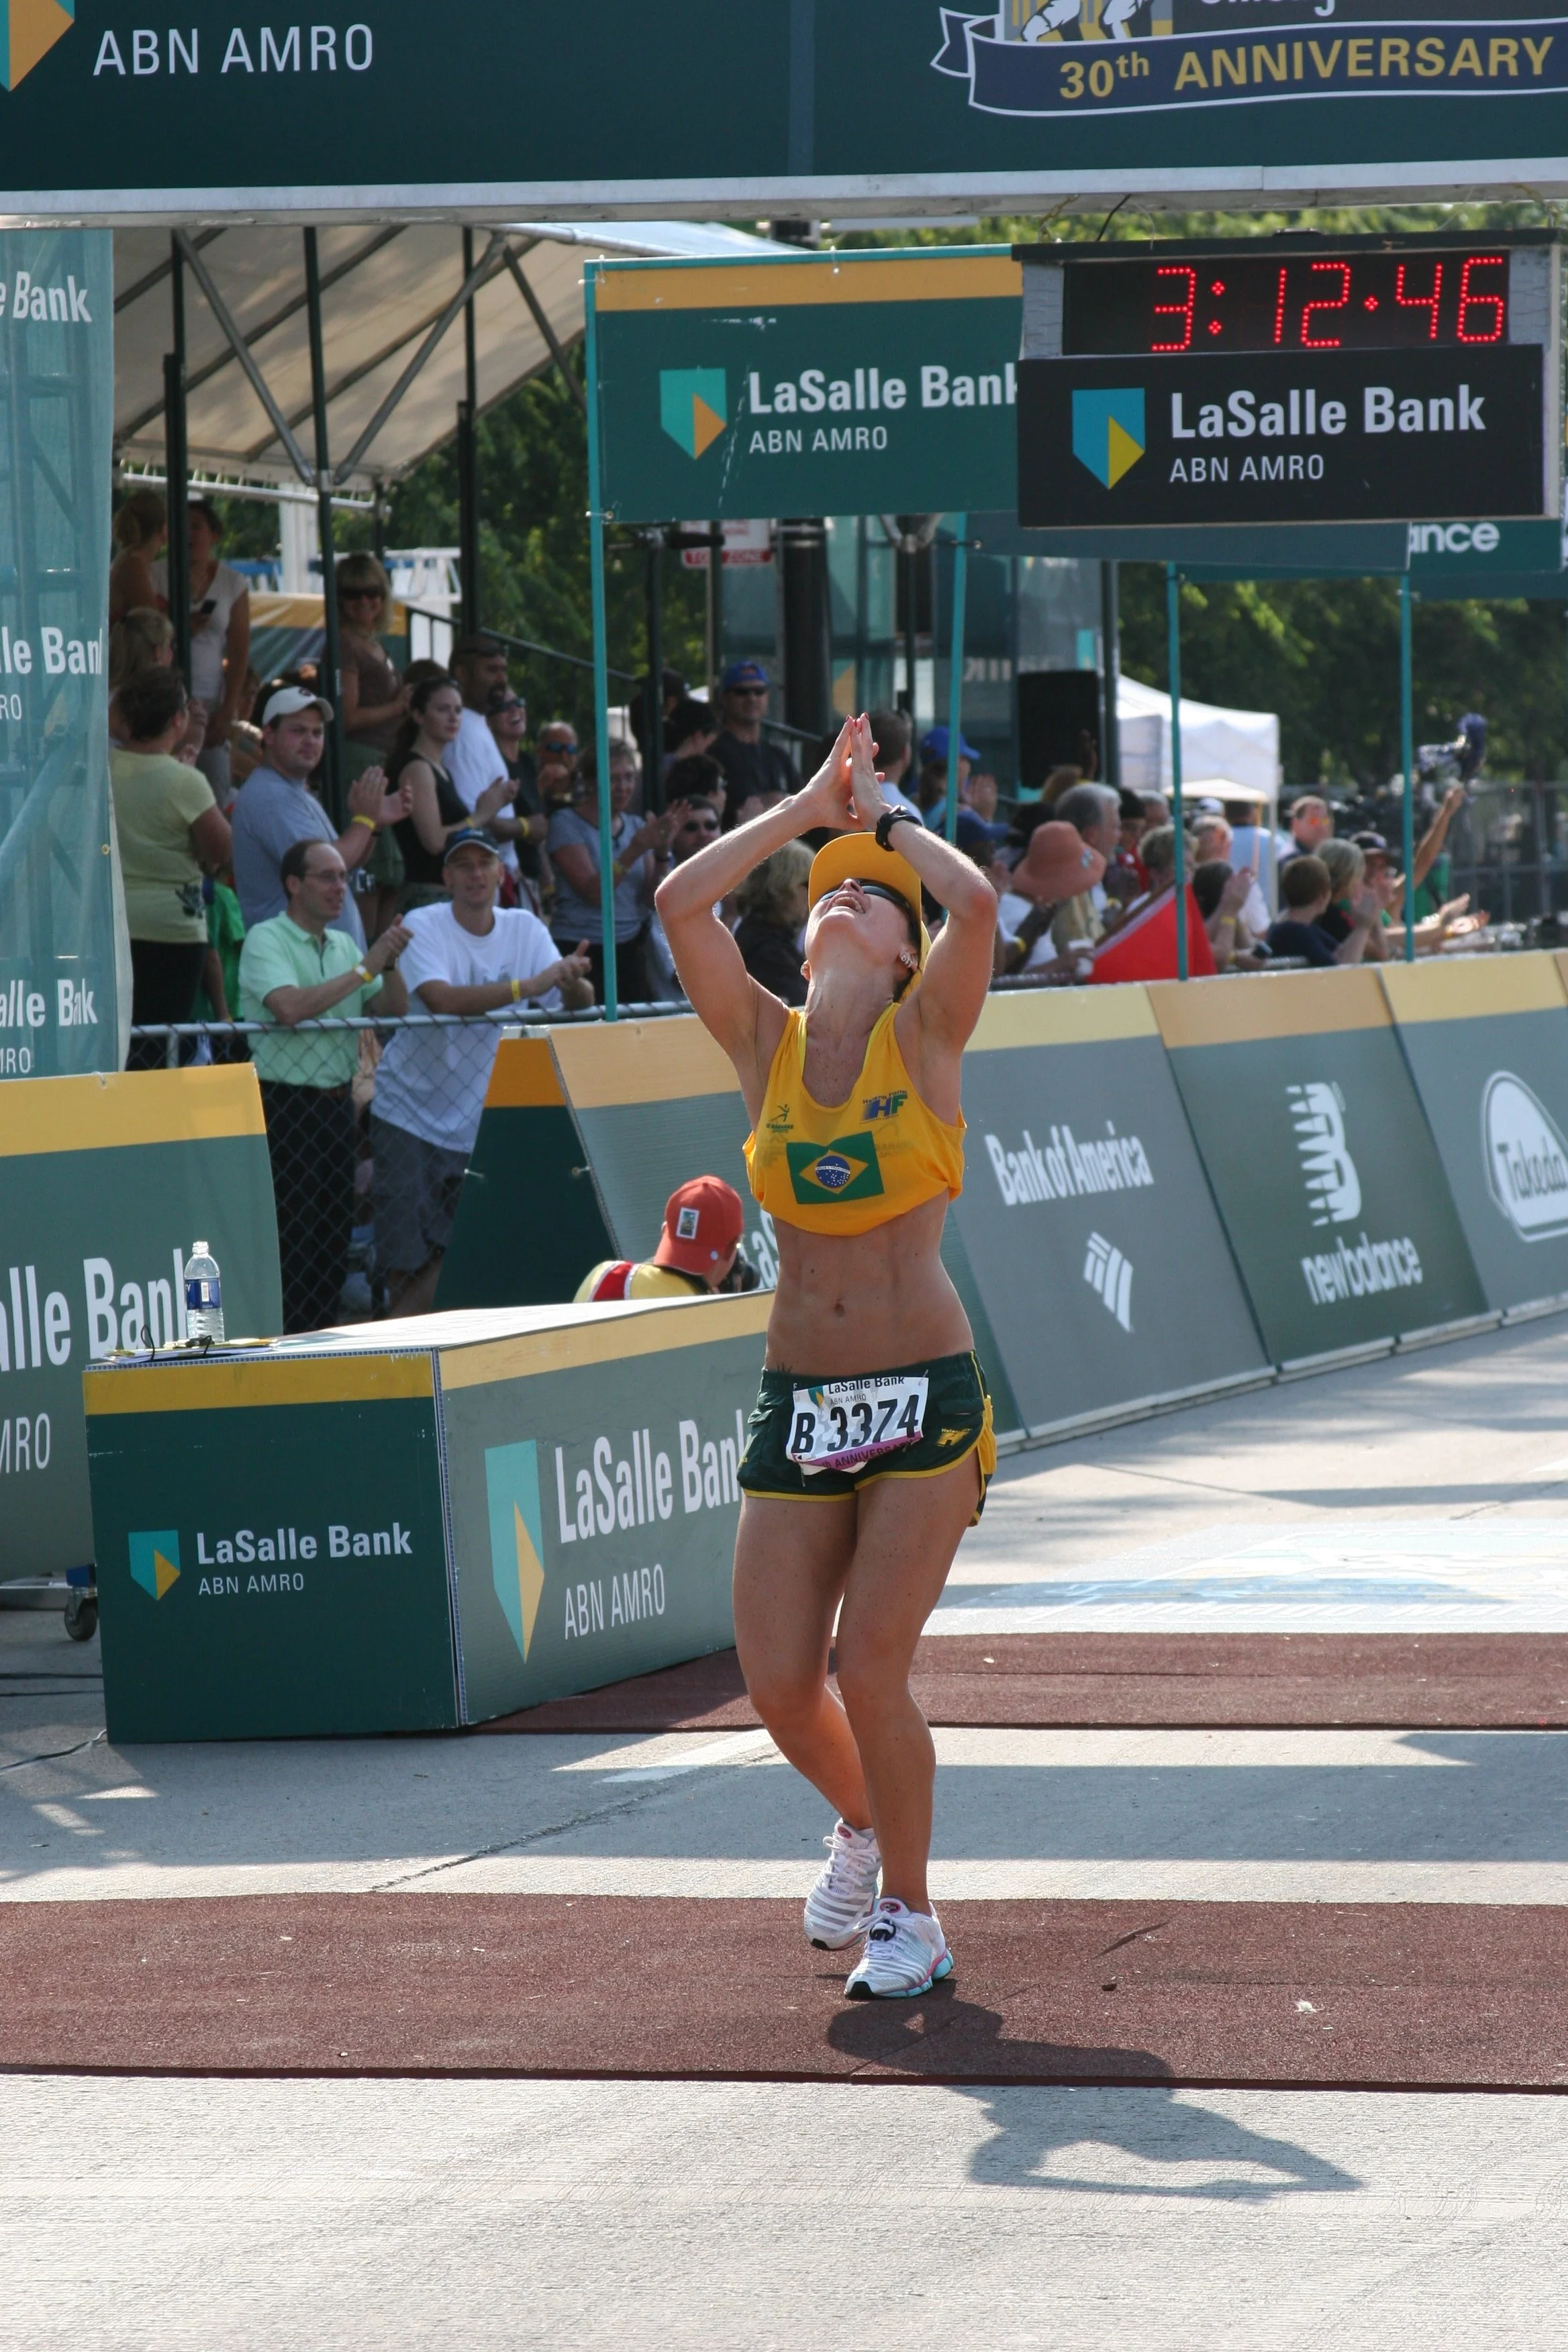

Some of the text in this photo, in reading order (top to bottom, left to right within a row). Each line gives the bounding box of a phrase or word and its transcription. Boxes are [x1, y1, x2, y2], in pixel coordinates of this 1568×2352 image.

[93, 23, 373, 76] ABN AMRO
[1059, 36, 1554, 99] 30th ANNIVERSARY
[13, 271, 92, 322] Bank
[748, 368, 907, 413] LaSalle
[1171, 384, 1486, 438] LaSalle Bank
[748, 426, 888, 454] ABN AMRO
[1169, 453, 1325, 483] ABN AMRO
[41, 626, 102, 674] Ban
[985, 1120, 1155, 1206] Bank of America
[828, 1376, 905, 1395] LaSalle Bank
[830, 1393, 867, 1406] ABN AMRO
[792, 1394, 920, 1453] B 3374
[555, 1428, 673, 1544] LaSalle
[196, 1522, 413, 1565] LaSalle Bank
[199, 1573, 305, 1596] ABN AMRO
[564, 1564, 665, 1640] ABN AMRO
